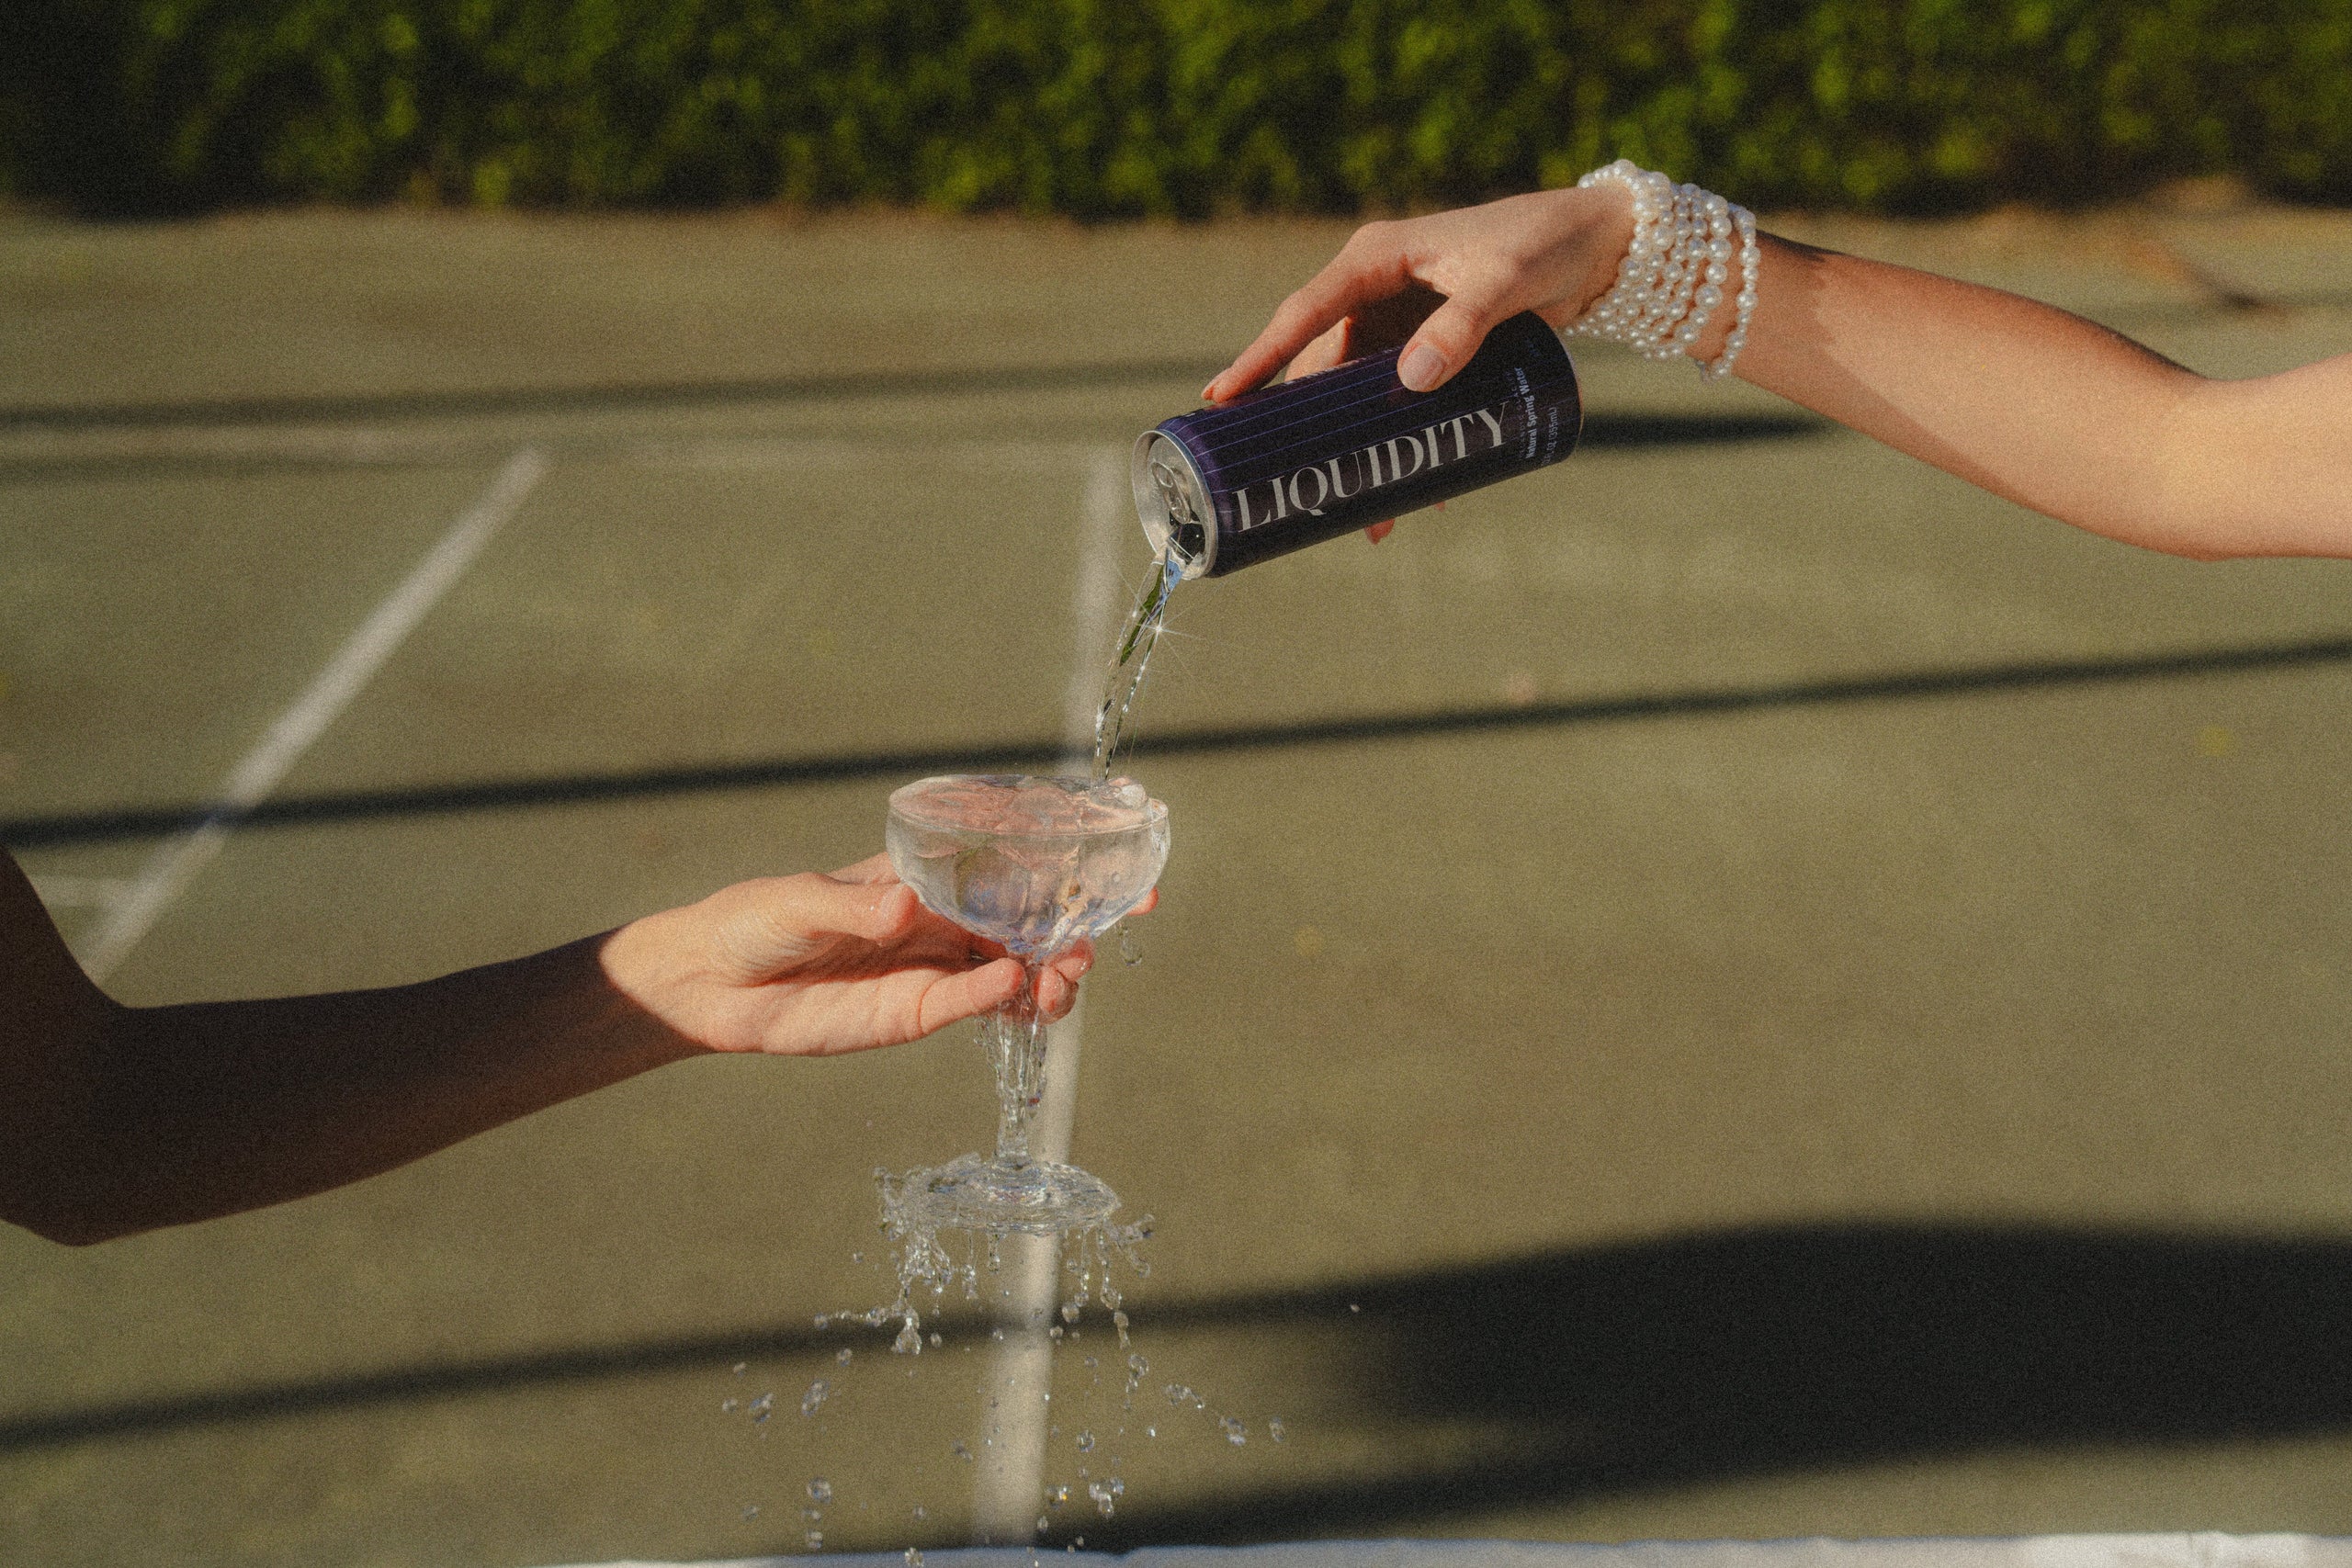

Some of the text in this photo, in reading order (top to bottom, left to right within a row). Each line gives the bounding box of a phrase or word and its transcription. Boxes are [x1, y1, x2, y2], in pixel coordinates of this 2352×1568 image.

[1232, 401, 1510, 532] LIQUIDITY
[1514, 367, 1538, 458] Natural Spring Water
